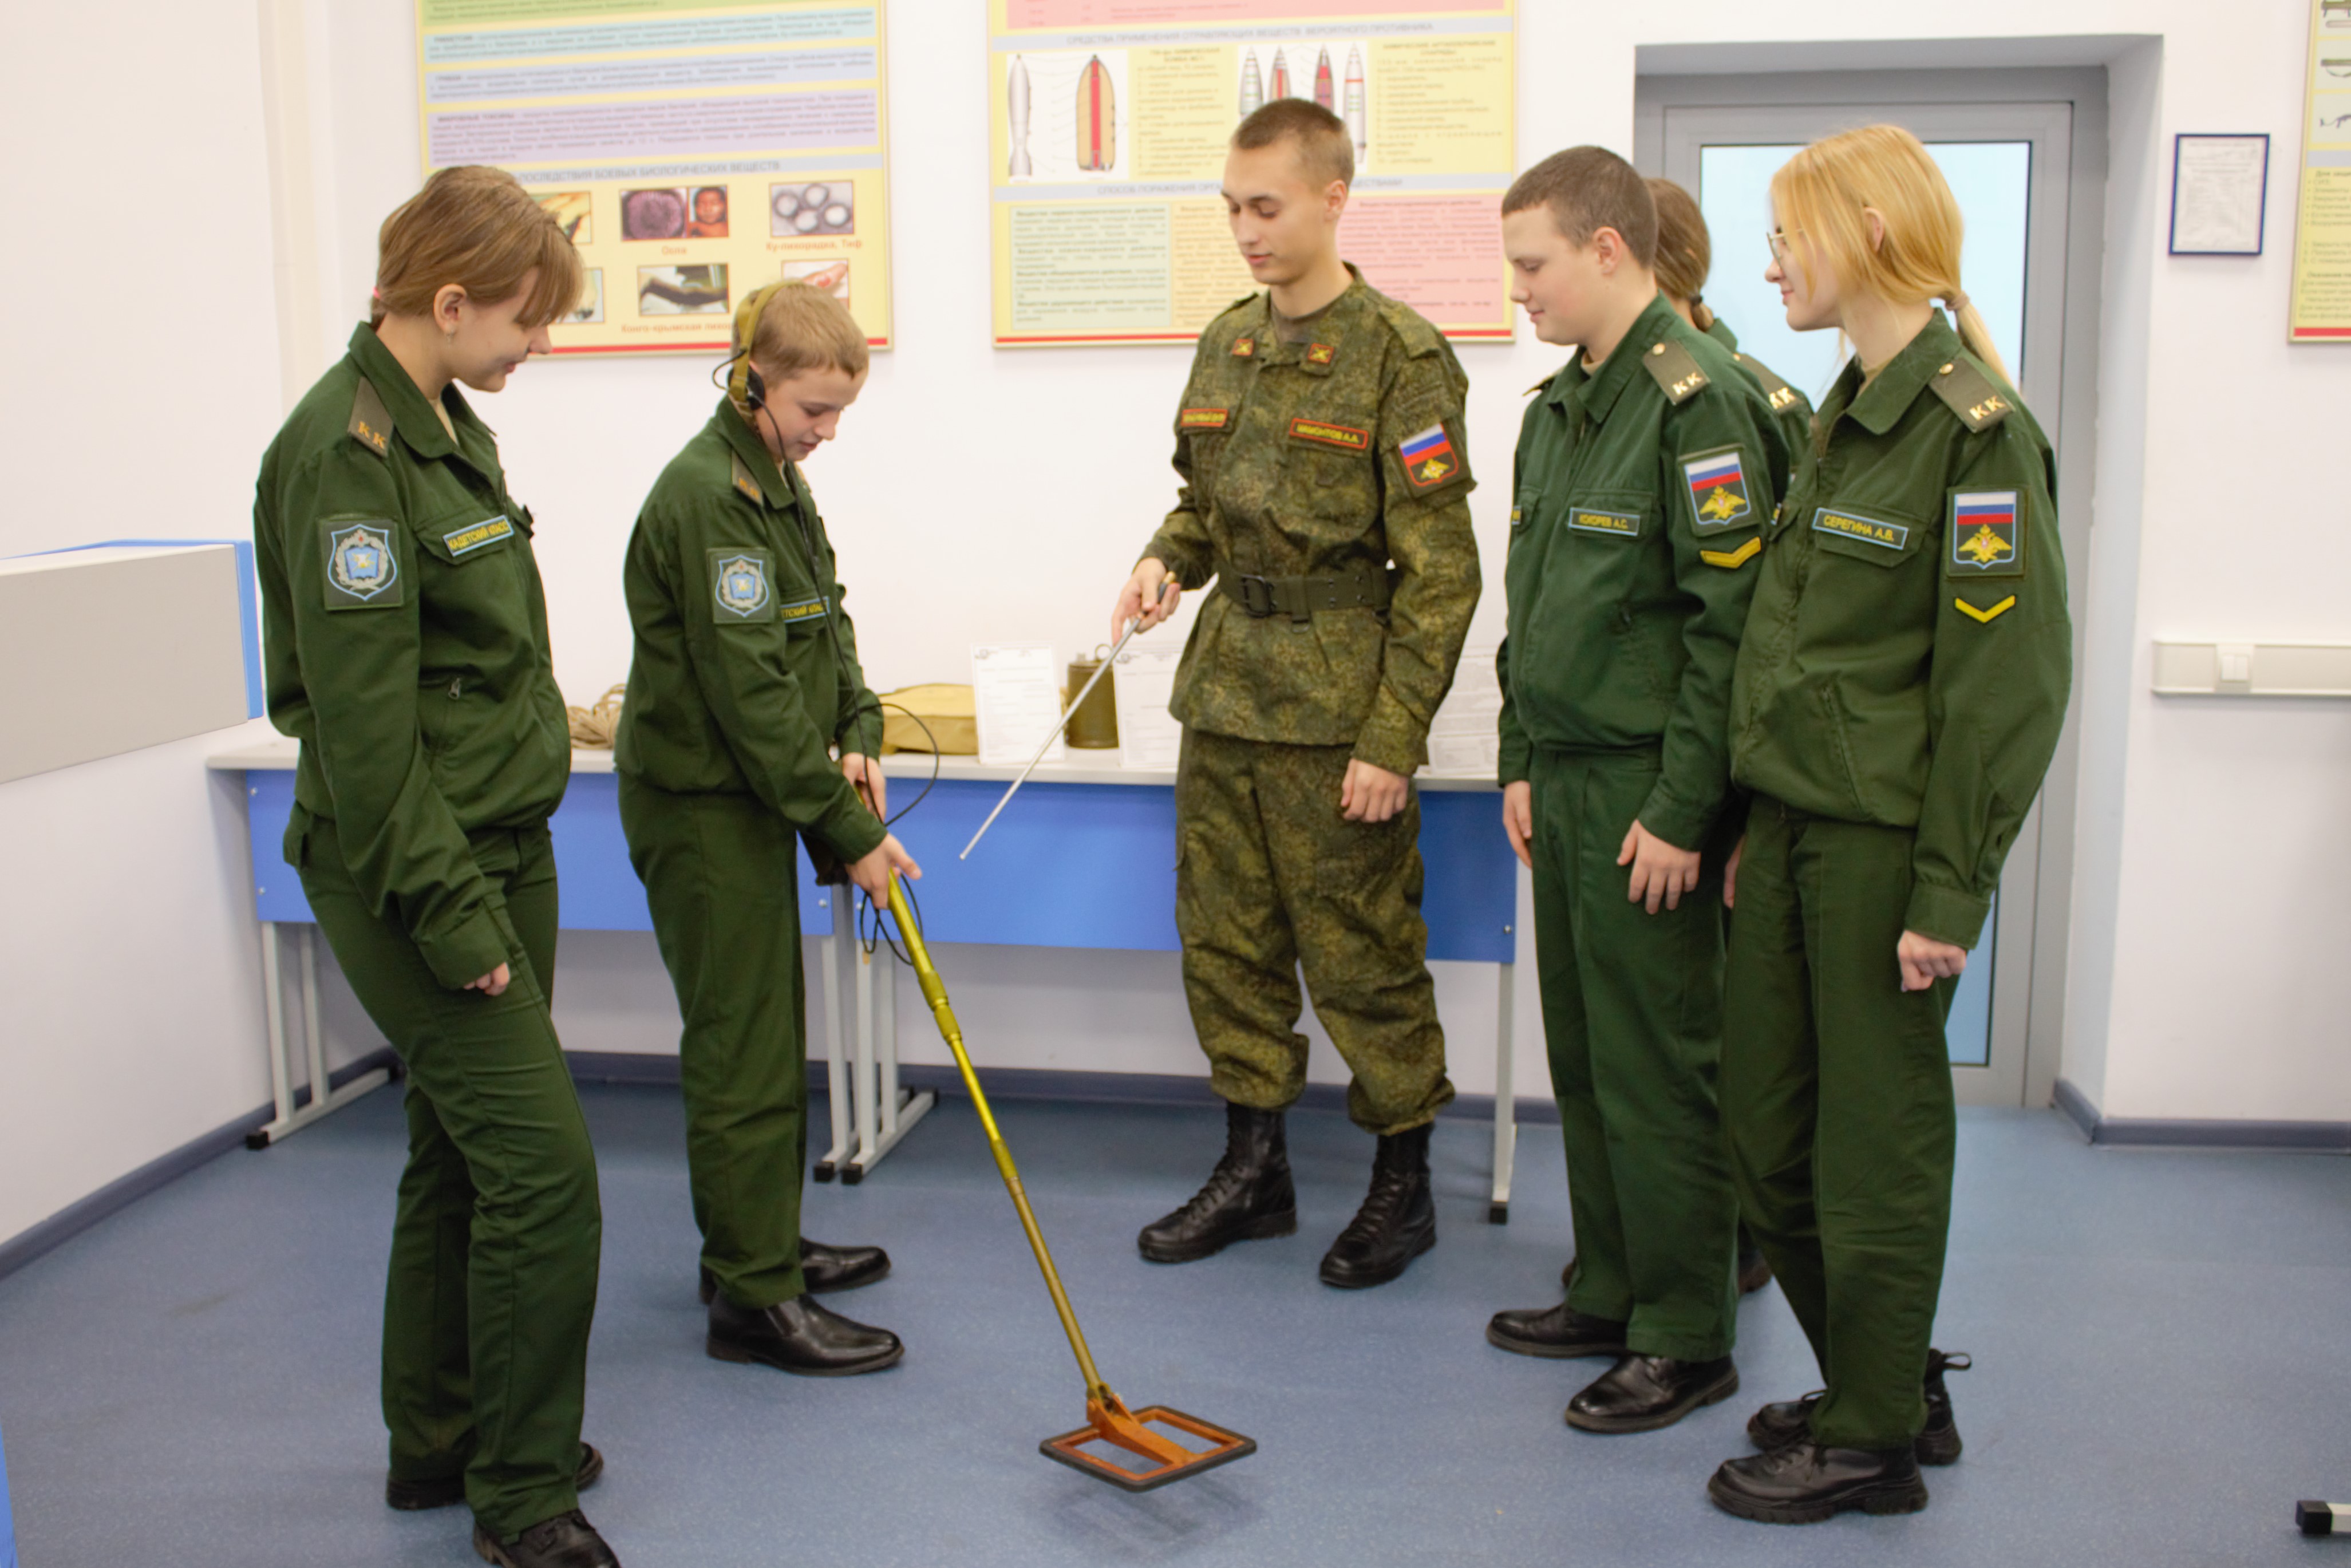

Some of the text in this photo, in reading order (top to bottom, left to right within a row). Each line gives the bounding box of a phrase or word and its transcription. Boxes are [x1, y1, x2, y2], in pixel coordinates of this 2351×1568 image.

[595, 168, 637, 180] БОЕВЫХ
[639, 164, 726, 177] БИОЛОГИЧЕСКИХ
[730, 161, 779, 173] ВЕЩЕСТВ
[661, 245, 687, 256] Оспа
[766, 239, 862, 252] Ку-лихорадка, Тиф
[621, 323, 701, 334] Конго-крымская
[1823, 515, 1872, 536] СЕРЕГИНА
[448, 519, 511, 551] КАДЕТСКИЙ КЛАСС
